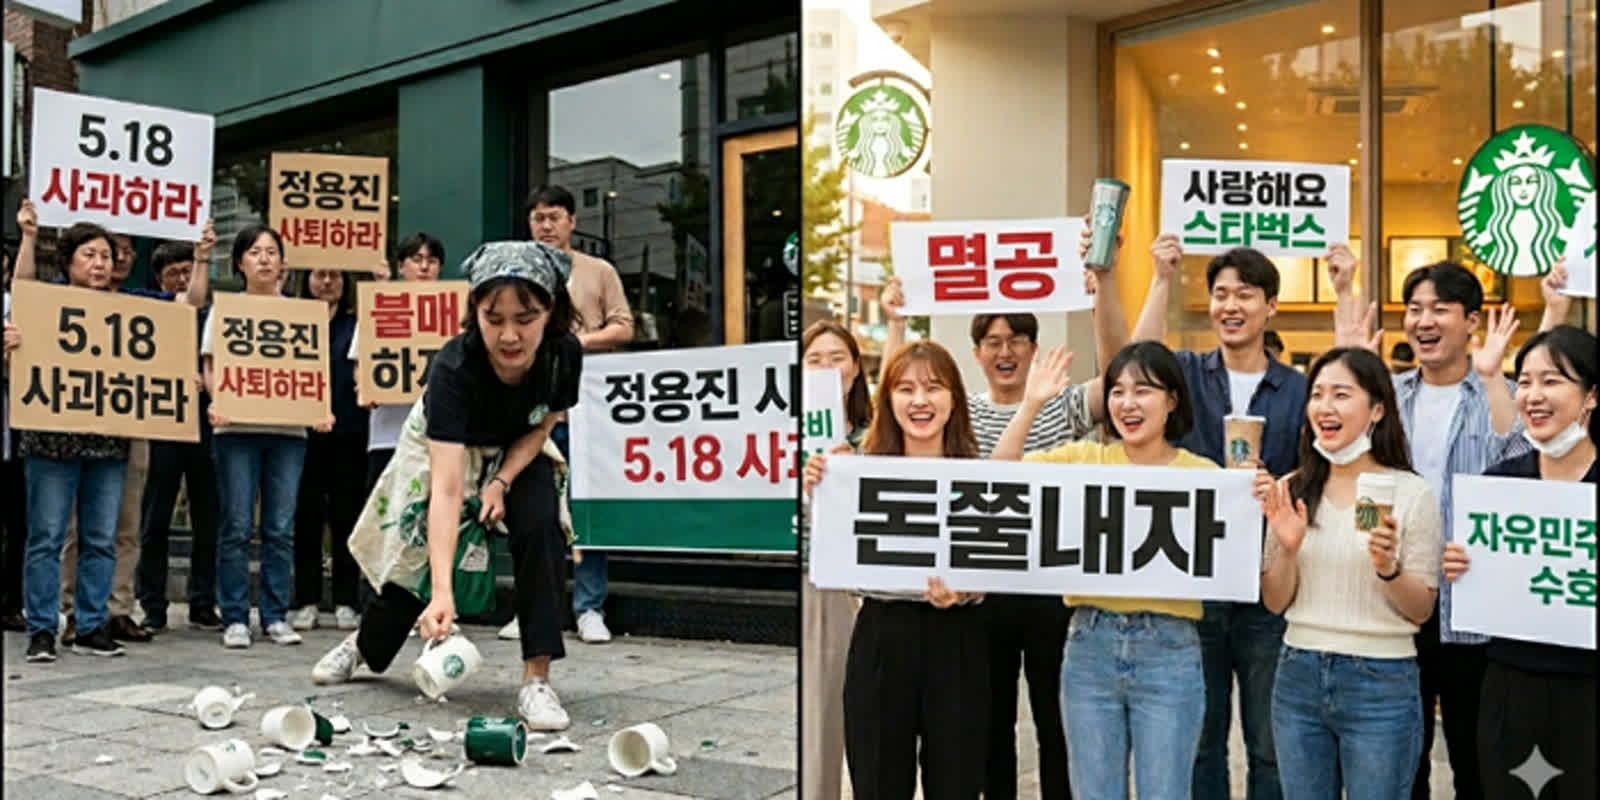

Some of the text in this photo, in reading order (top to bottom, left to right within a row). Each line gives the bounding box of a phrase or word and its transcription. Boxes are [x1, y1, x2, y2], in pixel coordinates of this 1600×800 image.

[78, 113, 174, 167] 5.18
[42, 168, 203, 225] 사과하라
[278, 170, 380, 212] 정용진
[1182, 170, 1328, 208] 사랑해요
[280, 217, 382, 250] 사퇴하라
[1182, 210, 1327, 249] 스타벅스
[927, 232, 1058, 301] 멸공
[57, 306, 157, 361] 5.18
[222, 317, 320, 361] 정용진
[370, 291, 459, 339] 불매
[21, 365, 190, 424] 사과하라
[218, 367, 327, 402] 사퇴하라
[604, 367, 739, 425] 정용진
[801, 408, 833, 439] 비
[623, 434, 723, 484] 5.18
[853, 476, 1226, 578] 돈쭐내자
[1467, 511, 1597, 561] 자유민주
[1530, 565, 1597, 608] 수호
